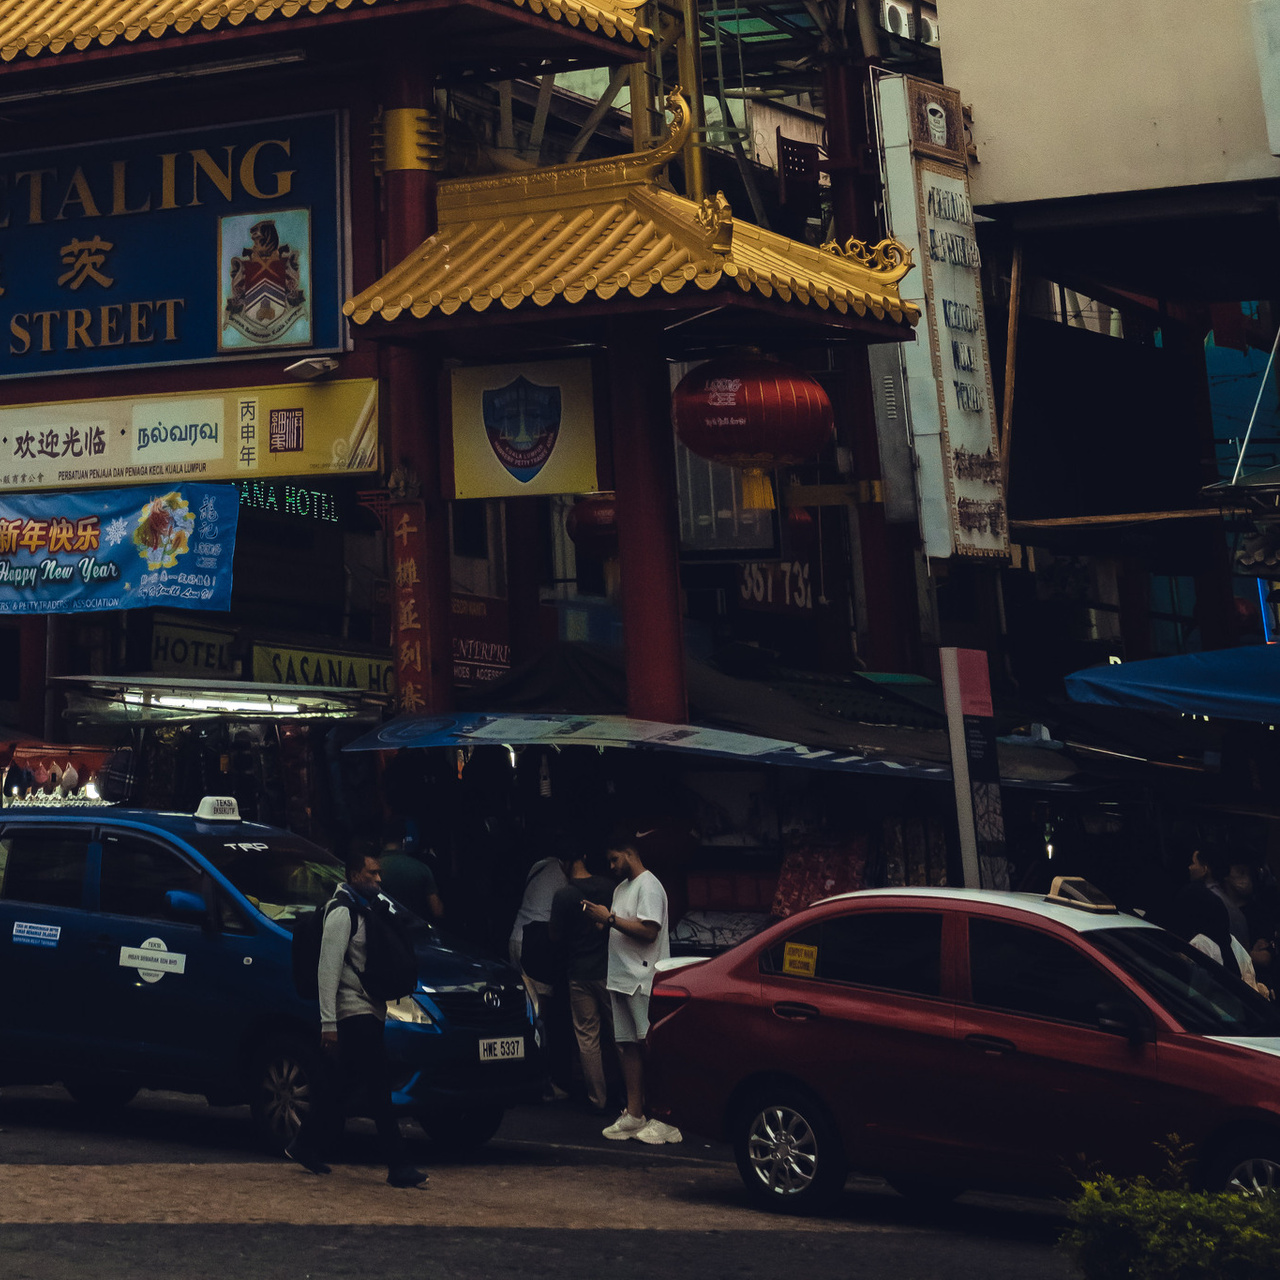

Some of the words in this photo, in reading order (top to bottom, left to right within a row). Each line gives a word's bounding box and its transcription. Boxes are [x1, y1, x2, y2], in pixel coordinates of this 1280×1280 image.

[10, 299, 185, 354] STREET
[13, 425, 106, 459] 欢迎光临
[239, 400, 257, 467] 丙申年
[58, 469, 89, 481] PERSATUAN
[89, 467, 112, 480] PENJAJA
[113, 466, 125, 478] DAN
[125, 465, 148, 477] PENIAGA
[149, 464, 164, 476] KECIL
[165, 463, 183, 474] KUALA
[183, 462, 207, 474] LUMPUR
[240, 481, 278, 511] ANA
[284, 486, 338, 522] HOTEL
[40, 557, 74, 581] New
[78, 557, 119, 583] Year
[19, 600, 39, 611] PETTY
[72, 597, 120, 609] ASSOCIATION
[154, 635, 233, 670] HOTEL
[271, 653, 359, 689] SASANA
[215, 799, 233, 807] TEKSI
[223, 842, 270, 853] TRD
[148, 941, 162, 949] TEKSI
[482, 1041, 498, 1058] HWE
[500, 1040, 520, 1056] 5337
